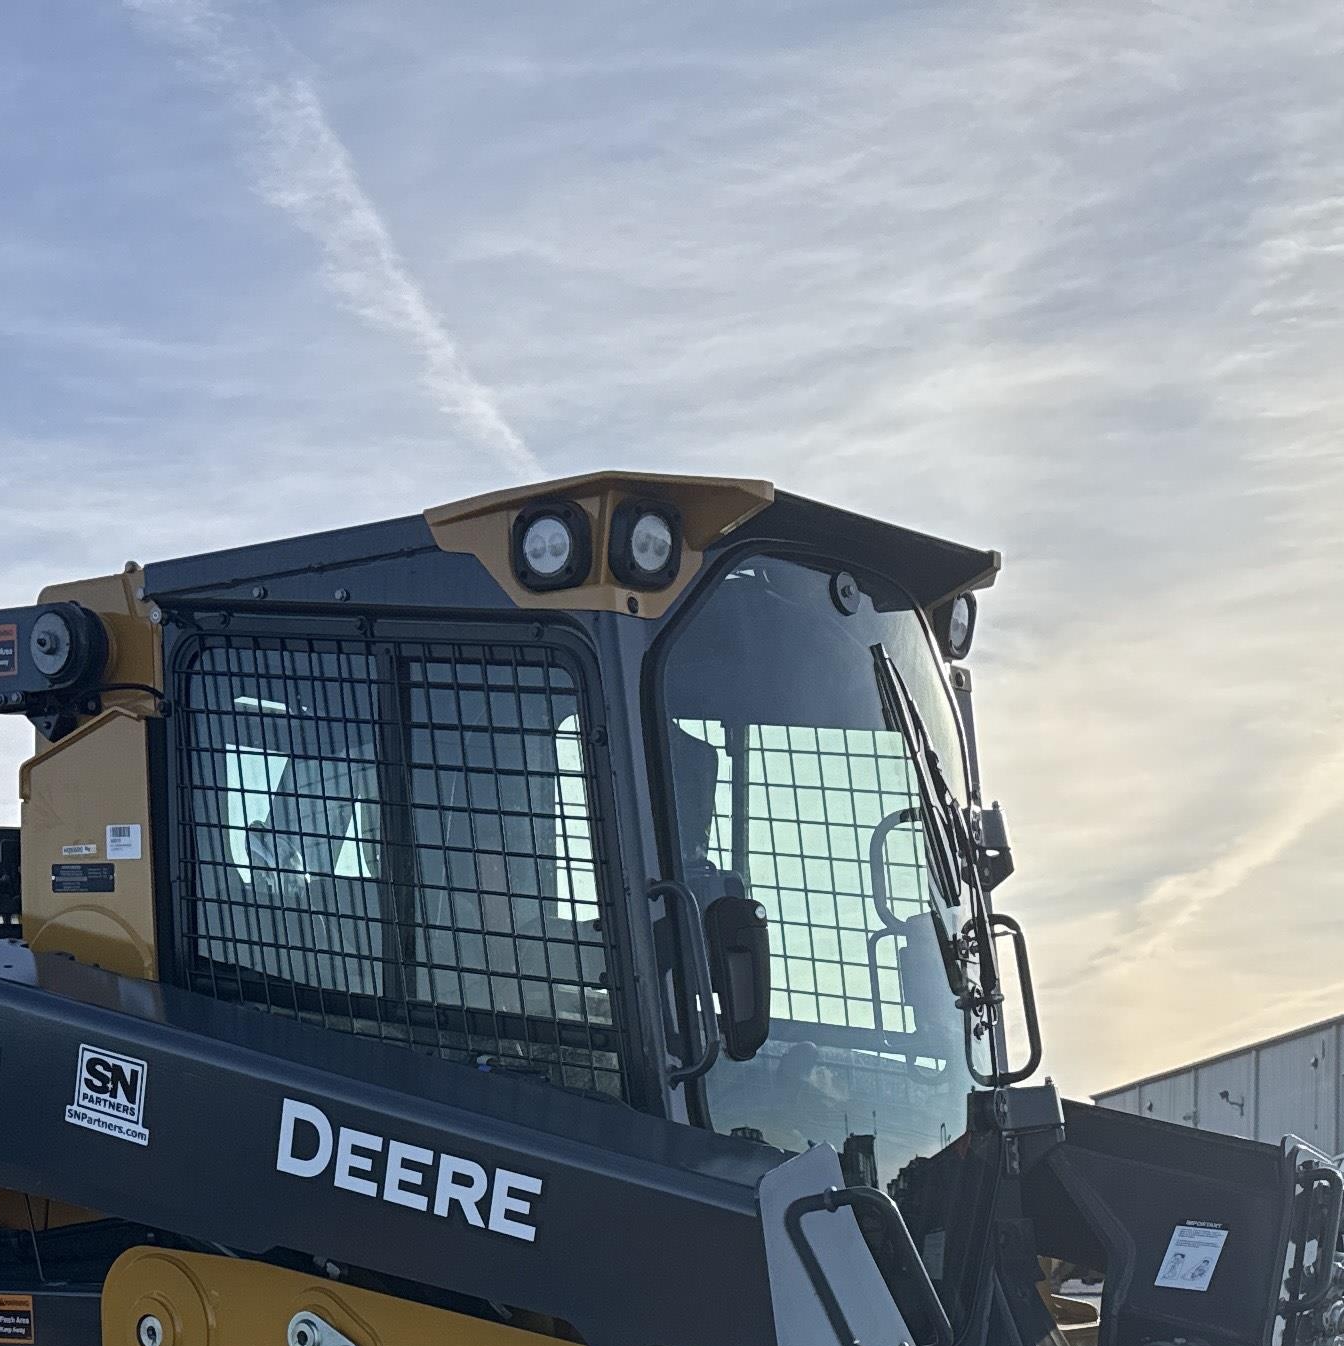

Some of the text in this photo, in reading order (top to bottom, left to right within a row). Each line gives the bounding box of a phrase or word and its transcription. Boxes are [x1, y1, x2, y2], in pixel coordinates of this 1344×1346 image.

[84, 1057, 139, 1105] SN
[67, 1108, 147, 1141] SNPartners.com
[82, 1092, 131, 1117] PARTNERS
[276, 1098, 543, 1242] DEERE
